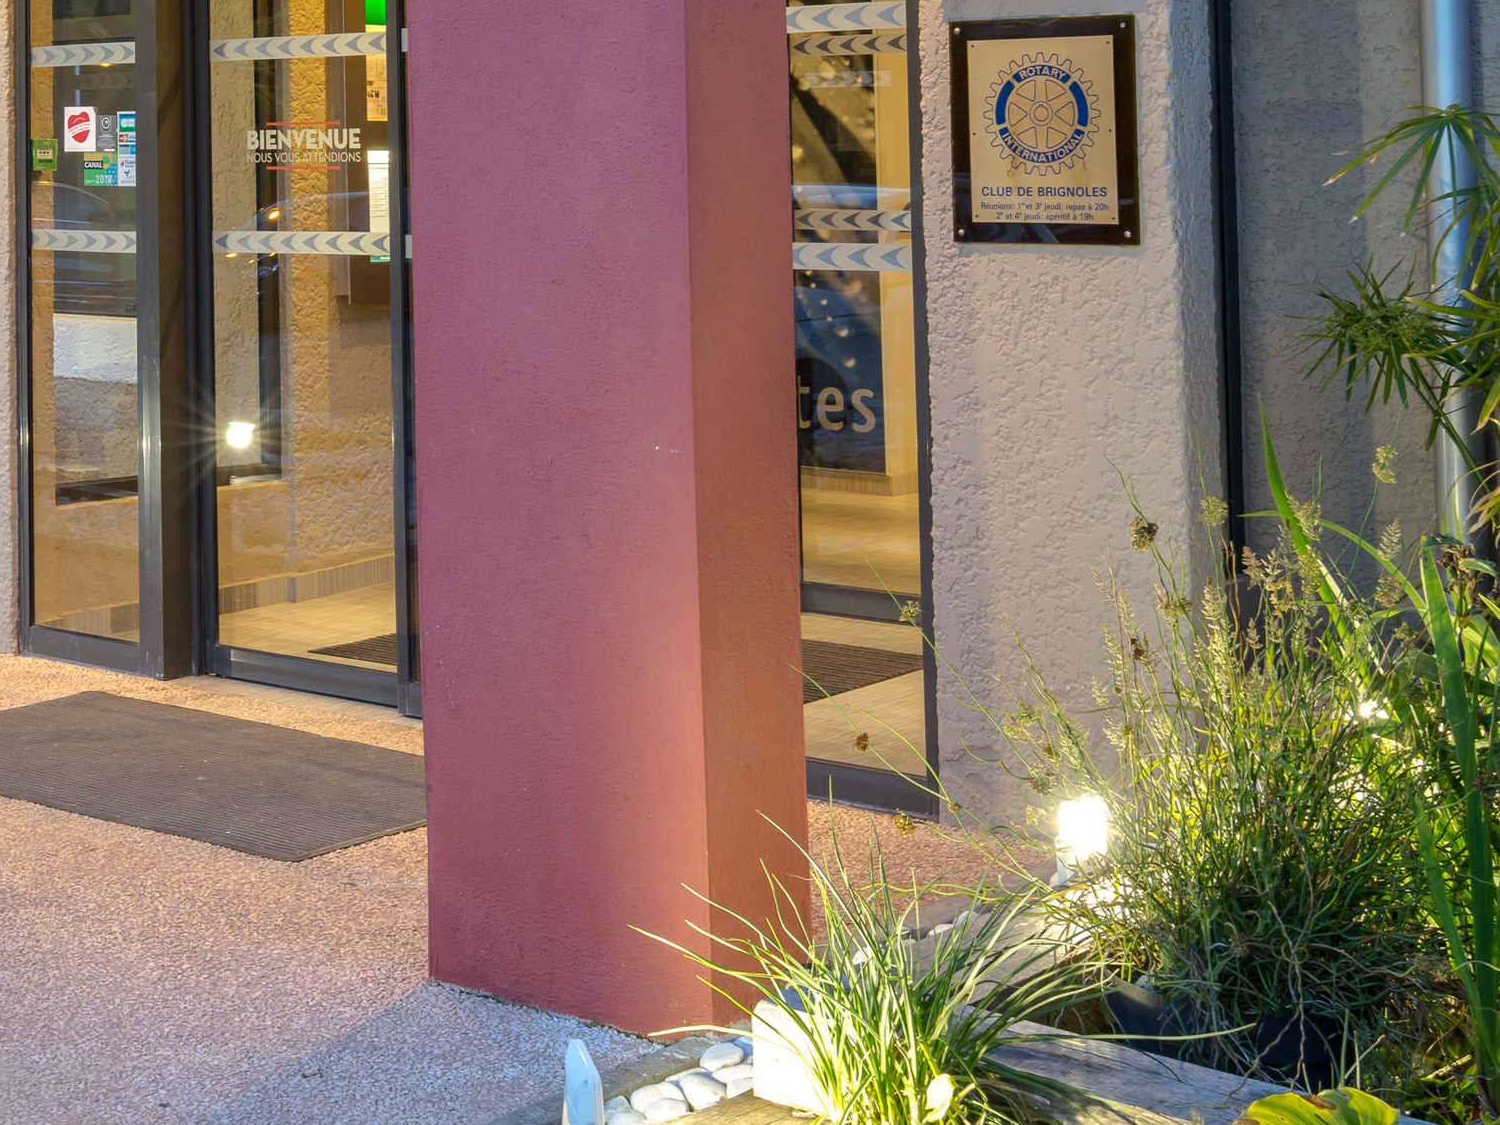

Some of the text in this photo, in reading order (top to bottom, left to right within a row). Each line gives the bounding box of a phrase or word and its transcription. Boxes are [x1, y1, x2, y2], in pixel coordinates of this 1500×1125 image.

[1019, 66, 1066, 80] ROTARY
[246, 128, 361, 150] BIENVENUE
[1001, 131, 1082, 163] INTERNATIONAL
[275, 152, 300, 163] VOUS
[302, 151, 362, 163] ATTENDIONS
[981, 186, 1108, 197] CLUB DE BRIGNOLES
